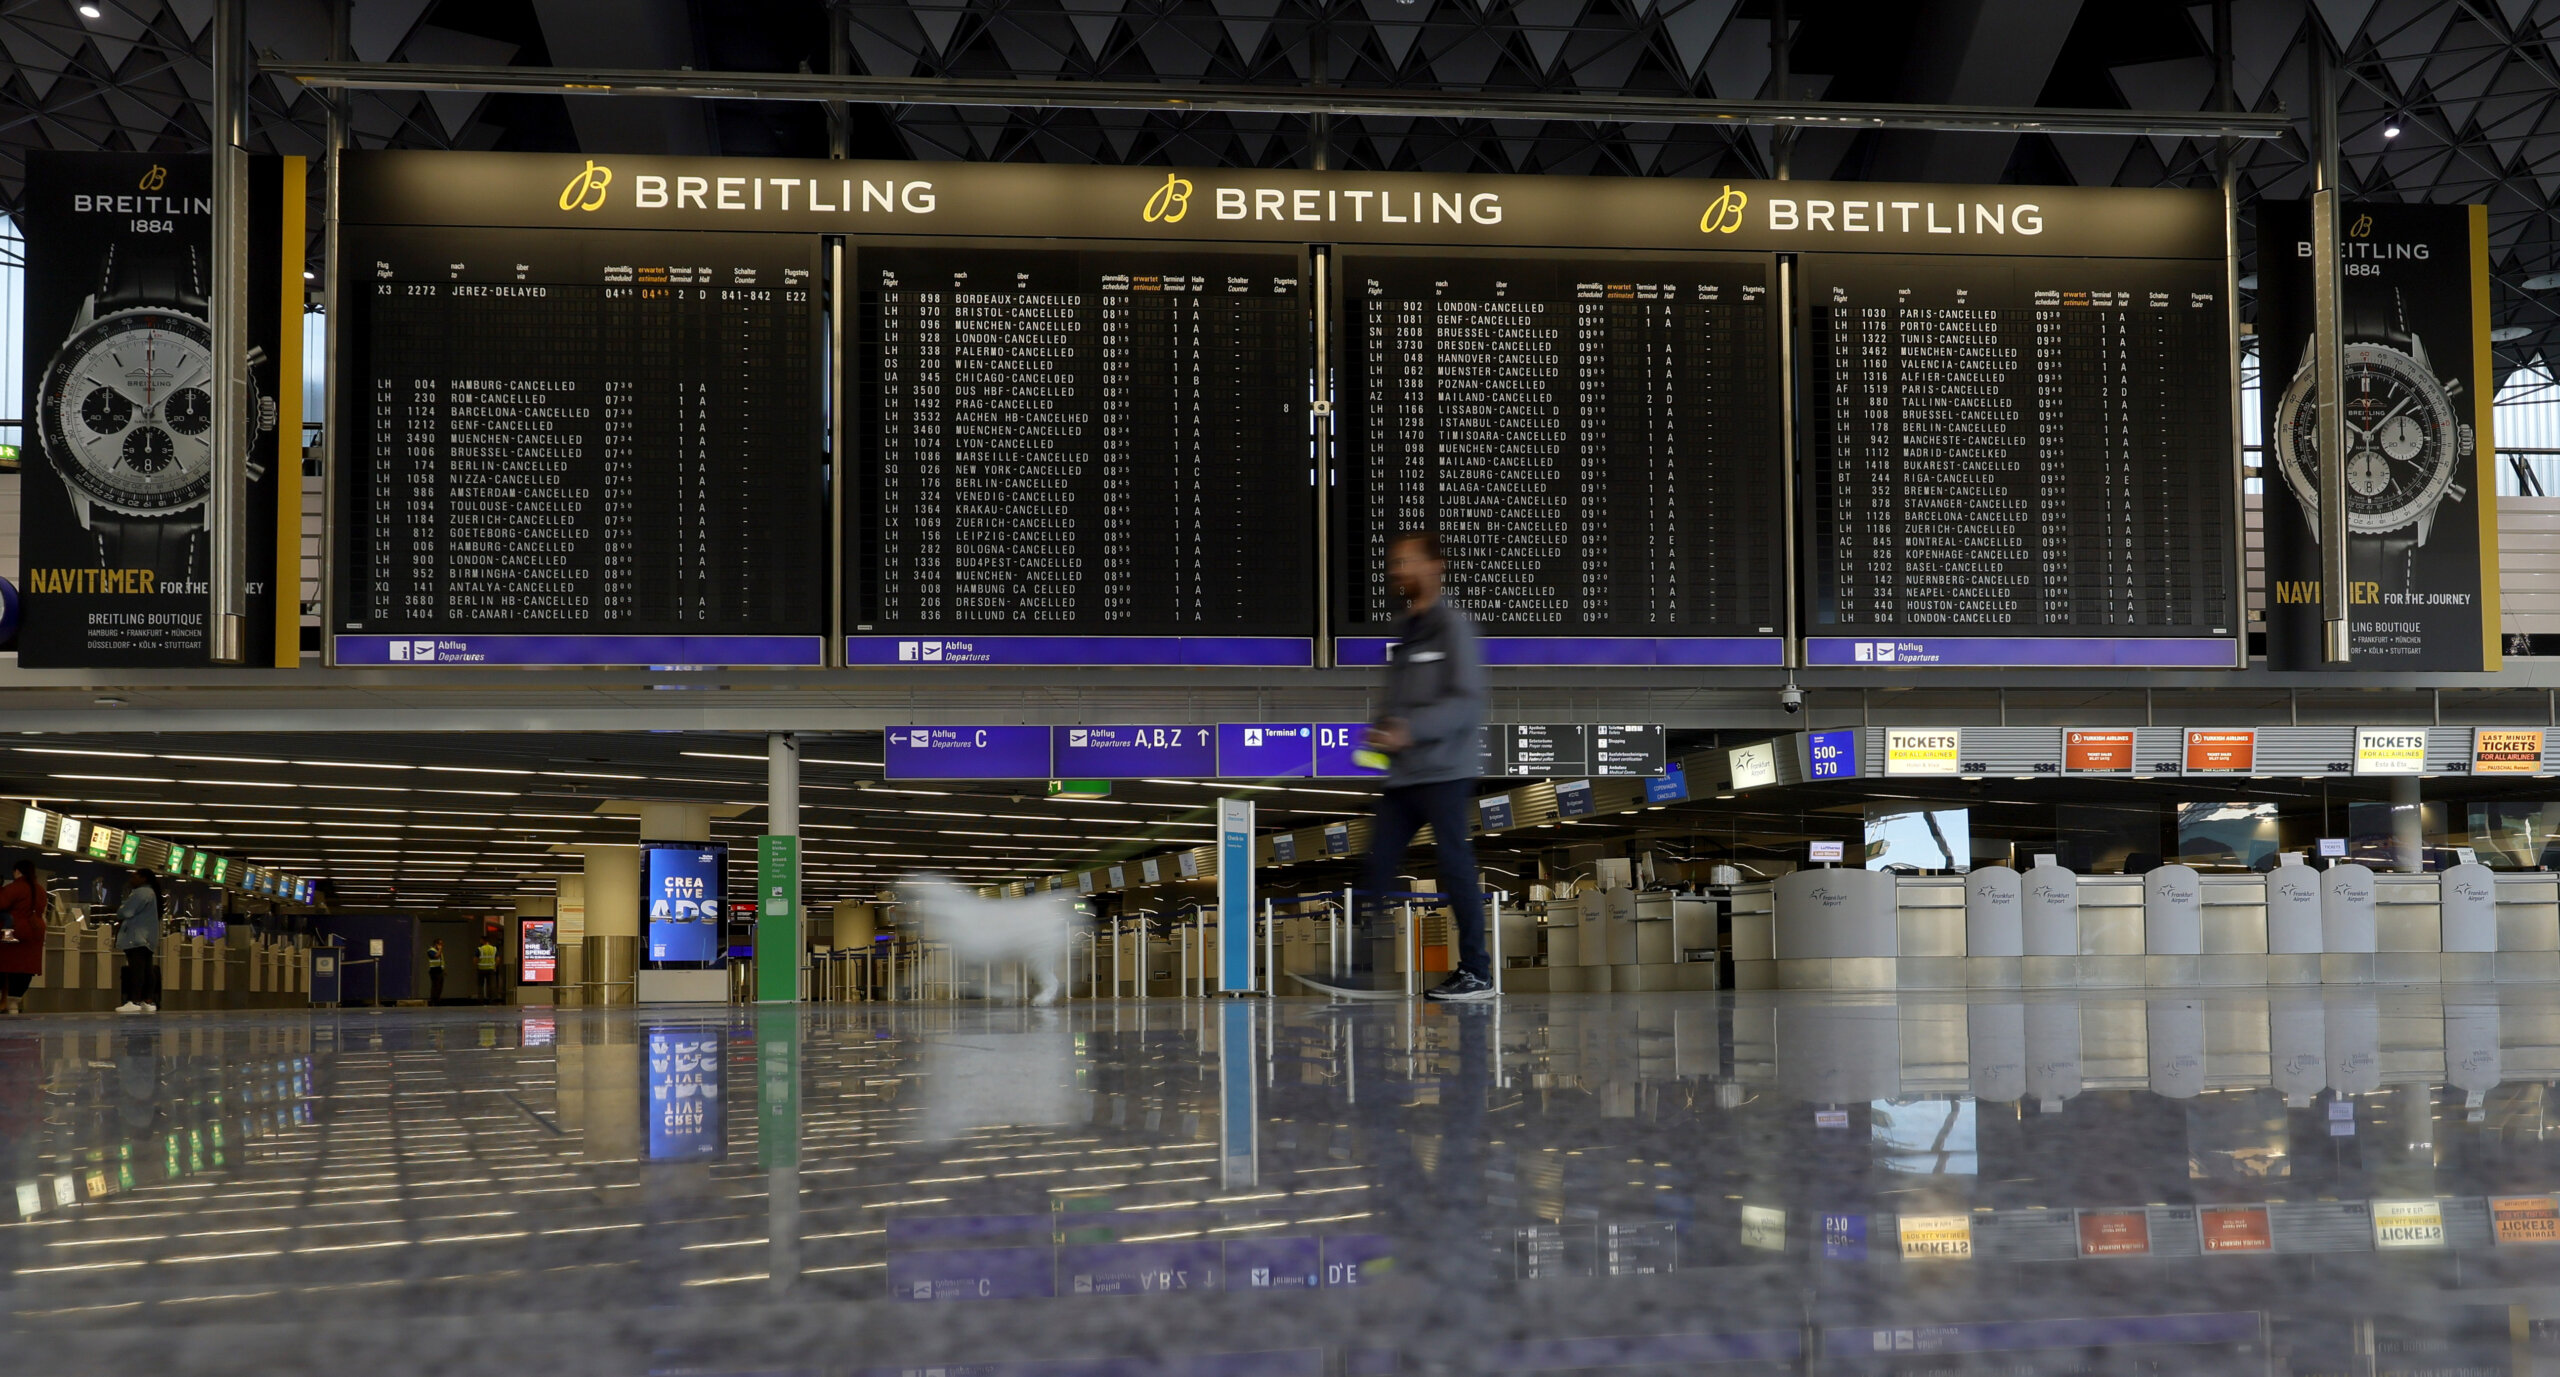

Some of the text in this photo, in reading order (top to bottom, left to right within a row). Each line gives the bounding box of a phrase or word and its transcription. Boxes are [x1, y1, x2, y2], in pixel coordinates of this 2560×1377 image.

[636, 176, 935, 213] BREITLING
[75, 195, 210, 214] BREITLIN
[1217, 189, 1501, 224] BREITLING
[1770, 200, 2042, 235] BREITLING
[130, 219, 174, 234] 1884
[2297, 241, 2429, 260] BEITLING
[2344, 263, 2381, 277] 1884
[378, 284, 392, 295] X3
[407, 285, 436, 296] 2272
[452, 285, 547, 298] JEREZ-DELAYED
[677, 290, 685, 300] 2
[698, 290, 707, 300] D
[721, 290, 771, 301] 841-842
[786, 291, 806, 302] E22
[885, 292, 1081, 306] LH 898 BORDEAUX-CANCELLED
[955, 306, 1074, 319] BRISTOL-CANCELLED
[1369, 301, 1544, 313] LH 902 LONDON-CANCELLED
[1436, 314, 1531, 326] GENF-CANCELLED
[1834, 308, 1997, 320] LH 1030 PARIS-CANCELLED
[1900, 321, 1997, 333] PORTO-CANCELLED
[955, 333, 1067, 345] LONDON-CANCELLED
[955, 346, 1074, 358] PALERMO-CANCELLED
[1437, 340, 1552, 352] DRESDEN-CANCELLED
[1900, 346, 2017, 358] MUENCHEN-CANCELLED
[1900, 359, 2018, 370] VALENCIA-CANCELLED
[377, 379, 575, 391] LH 004 HAMBURG-CANCELLED
[1438, 391, 1553, 403] MAILAND-CANCELLED
[955, 398, 1053, 410] PRAG-CANCELLED
[451, 406, 590, 418] BARCELONA-CANCELLED
[450, 419, 553, 431] GENF-CANCELLED
[1902, 422, 2007, 433] BERLIN-CANCELLED
[450, 433, 583, 445] MUENCHEN-CANCELLED
[1438, 430, 1567, 441] TIMISOARA-CANCELLED
[956, 438, 1054, 449] LYON-CANCELLED
[955, 451, 1089, 463] MARSEILLE-CANCELLED
[450, 460, 568, 472] BERLIN-CANCELLED
[1903, 460, 2020, 471] BUKAREST-CANCELLED
[1439, 469, 1560, 480] SALZBURG-CANCELLED
[449, 487, 589, 499] AMSTERDAM-CANCELLED
[1439, 482, 1547, 493] MALAGA-CANCELLED
[450, 500, 582, 512] TOULOUSE-CANCELLED
[1439, 495, 1567, 506] LJUBLJANA-CANCELLED
[1904, 498, 2028, 509] STAVANGER-CANCELLED
[955, 517, 1075, 529] ZUERICH-CANCELLED
[449, 527, 589, 539] GOETEBORG-CANCELLED
[1439, 533, 1568, 545] CHARLOTTE-CANCELLED
[1905, 536, 2022, 547] MONTREAL-CANCELLED
[956, 544, 1075, 555] BOLOGNA-CANCELLED
[449, 554, 567, 566] LONDON-CANCELLED
[31, 569, 208, 594] NAVITIMER FOR THE
[1906, 575, 2030, 585] NUERNBERG-CANCELLED
[449, 581, 574, 593] ANTALYA-CANCELLED
[2384, 593, 2404, 605] FOR
[2406, 594, 2425, 605] THE
[2426, 593, 2471, 605] JOURNEY
[88, 613, 203, 626] BREITLING BOUTIQUE
[1907, 613, 2011, 623] LONDON-CANCELLED
[87, 628, 202, 637] HAMBURG FRANKFURT MÜNCHEN
[2375, 621, 2421, 634] BOUTIQUE
[87, 640, 202, 649] DÜSSELDORF KÖLN STUTTGART
[2357, 635, 2422, 644] FRANKFURT MÜNCHEN
[438, 640, 467, 652] Abflug
[945, 641, 973, 652] Abflug
[1897, 642, 1923, 653] Abflug
[2368, 646, 2384, 655] KÖLN
[2390, 647, 2422, 655] STUTTGART
[438, 651, 485, 663] Departures
[945, 652, 991, 663] Departures
[1898, 653, 1940, 664] Departures
[931, 729, 957, 740] Abflug
[1090, 729, 1116, 739] Abflug
[1264, 728, 1297, 737] Terminal
[1321, 729, 1348, 748] D,E
[931, 730, 986, 750] Departures C
[1090, 729, 1181, 749] Departures A,B,Z
[1892, 736, 1956, 749] TICKETS
[2362, 736, 2423, 748] TICKETS
[1814, 745, 1843, 760] 500-
[2483, 742, 2536, 751] TICKETS
[1815, 761, 1838, 776] 570
[1964, 763, 1987, 772] 535
[2034, 763, 2056, 772] 534
[2155, 763, 2177, 772] 533
[2327, 762, 2350, 772] 532
[2446, 763, 2467, 772] 531
[664, 877, 704, 888] CREA
[664, 888, 703, 898] TIVE
[649, 899, 718, 924] ADS
